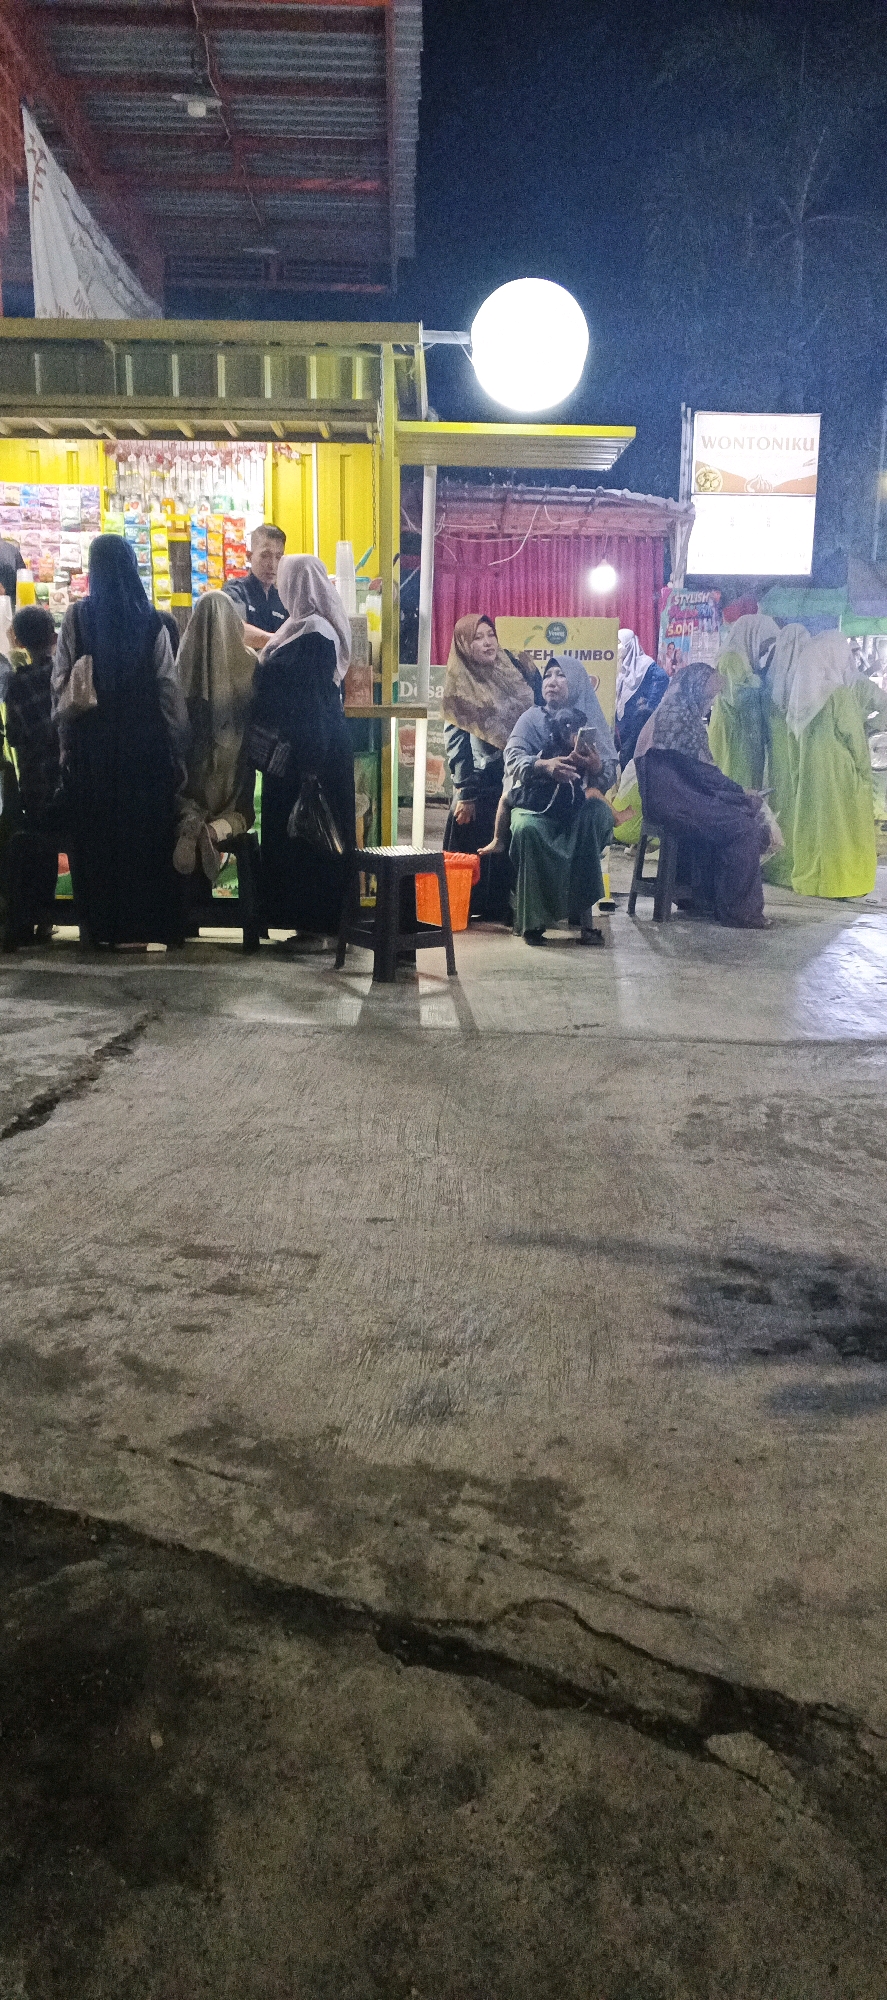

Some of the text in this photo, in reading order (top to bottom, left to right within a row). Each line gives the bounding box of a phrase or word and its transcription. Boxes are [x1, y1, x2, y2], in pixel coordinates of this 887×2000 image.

[701, 435, 815, 452] WONTONIKU
[674, 590, 711, 606] STYLISH
[524, 649, 554, 660] TEH
